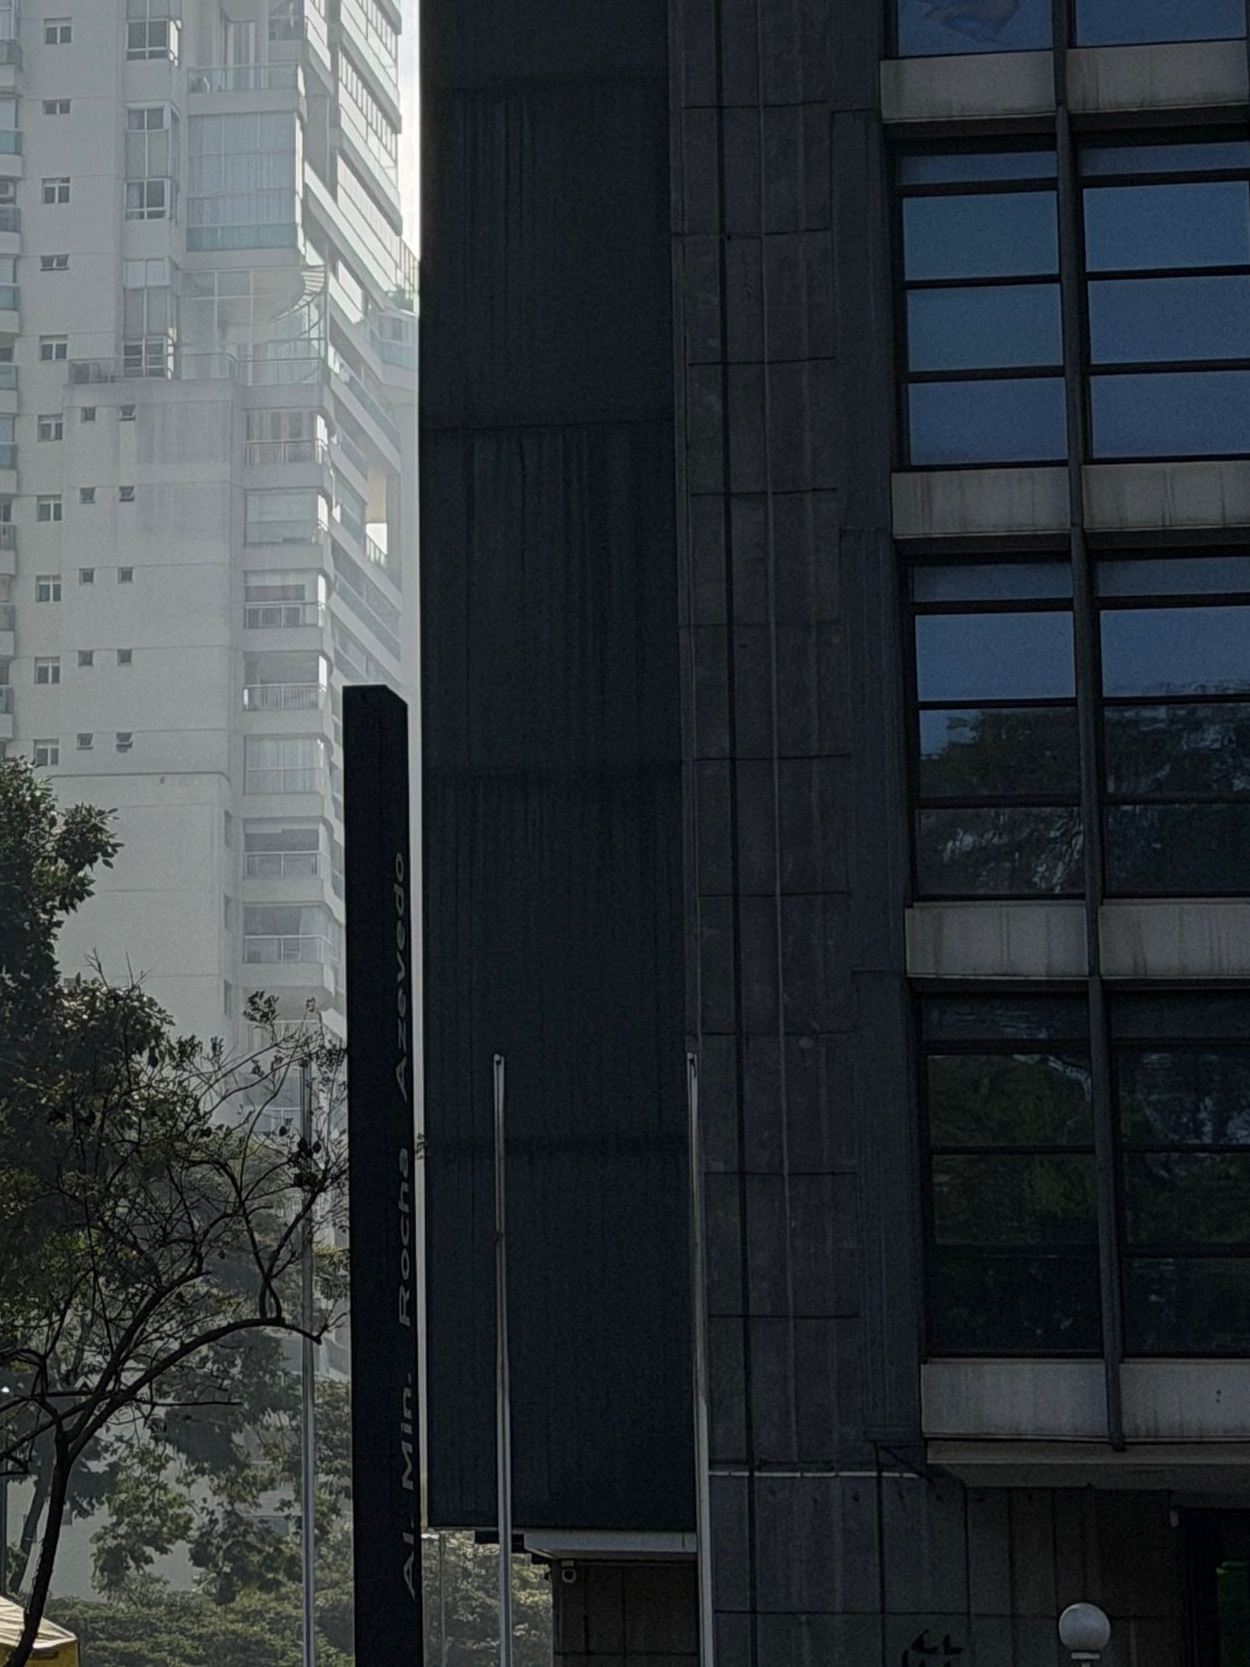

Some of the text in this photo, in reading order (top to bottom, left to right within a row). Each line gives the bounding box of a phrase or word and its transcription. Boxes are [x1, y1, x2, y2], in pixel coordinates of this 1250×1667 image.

[393, 850, 409, 1104] Azevedo
[397, 1146, 412, 1328] Rocha
[401, 1371, 416, 1492] Min.
